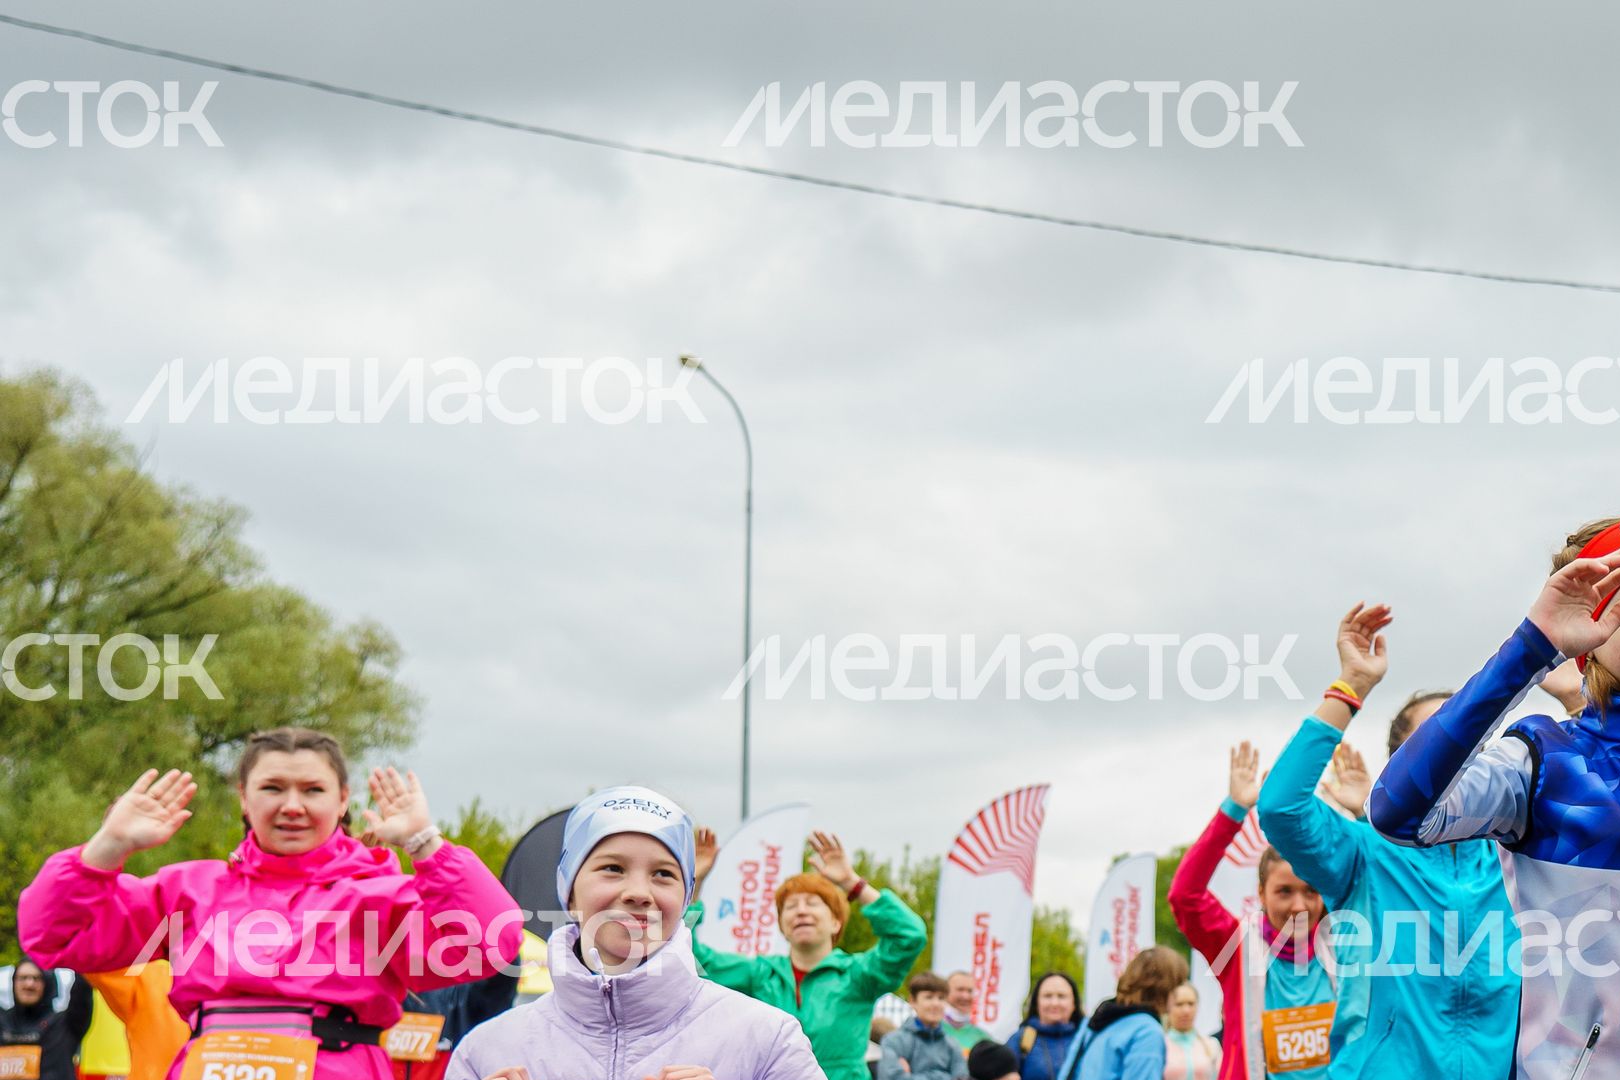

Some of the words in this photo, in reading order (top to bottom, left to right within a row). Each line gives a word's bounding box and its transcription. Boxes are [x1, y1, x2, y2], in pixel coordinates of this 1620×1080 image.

[603, 798, 672, 815] OZERY
[635, 806, 667, 819] TEAM
[1275, 1028, 1329, 1061] 5295
